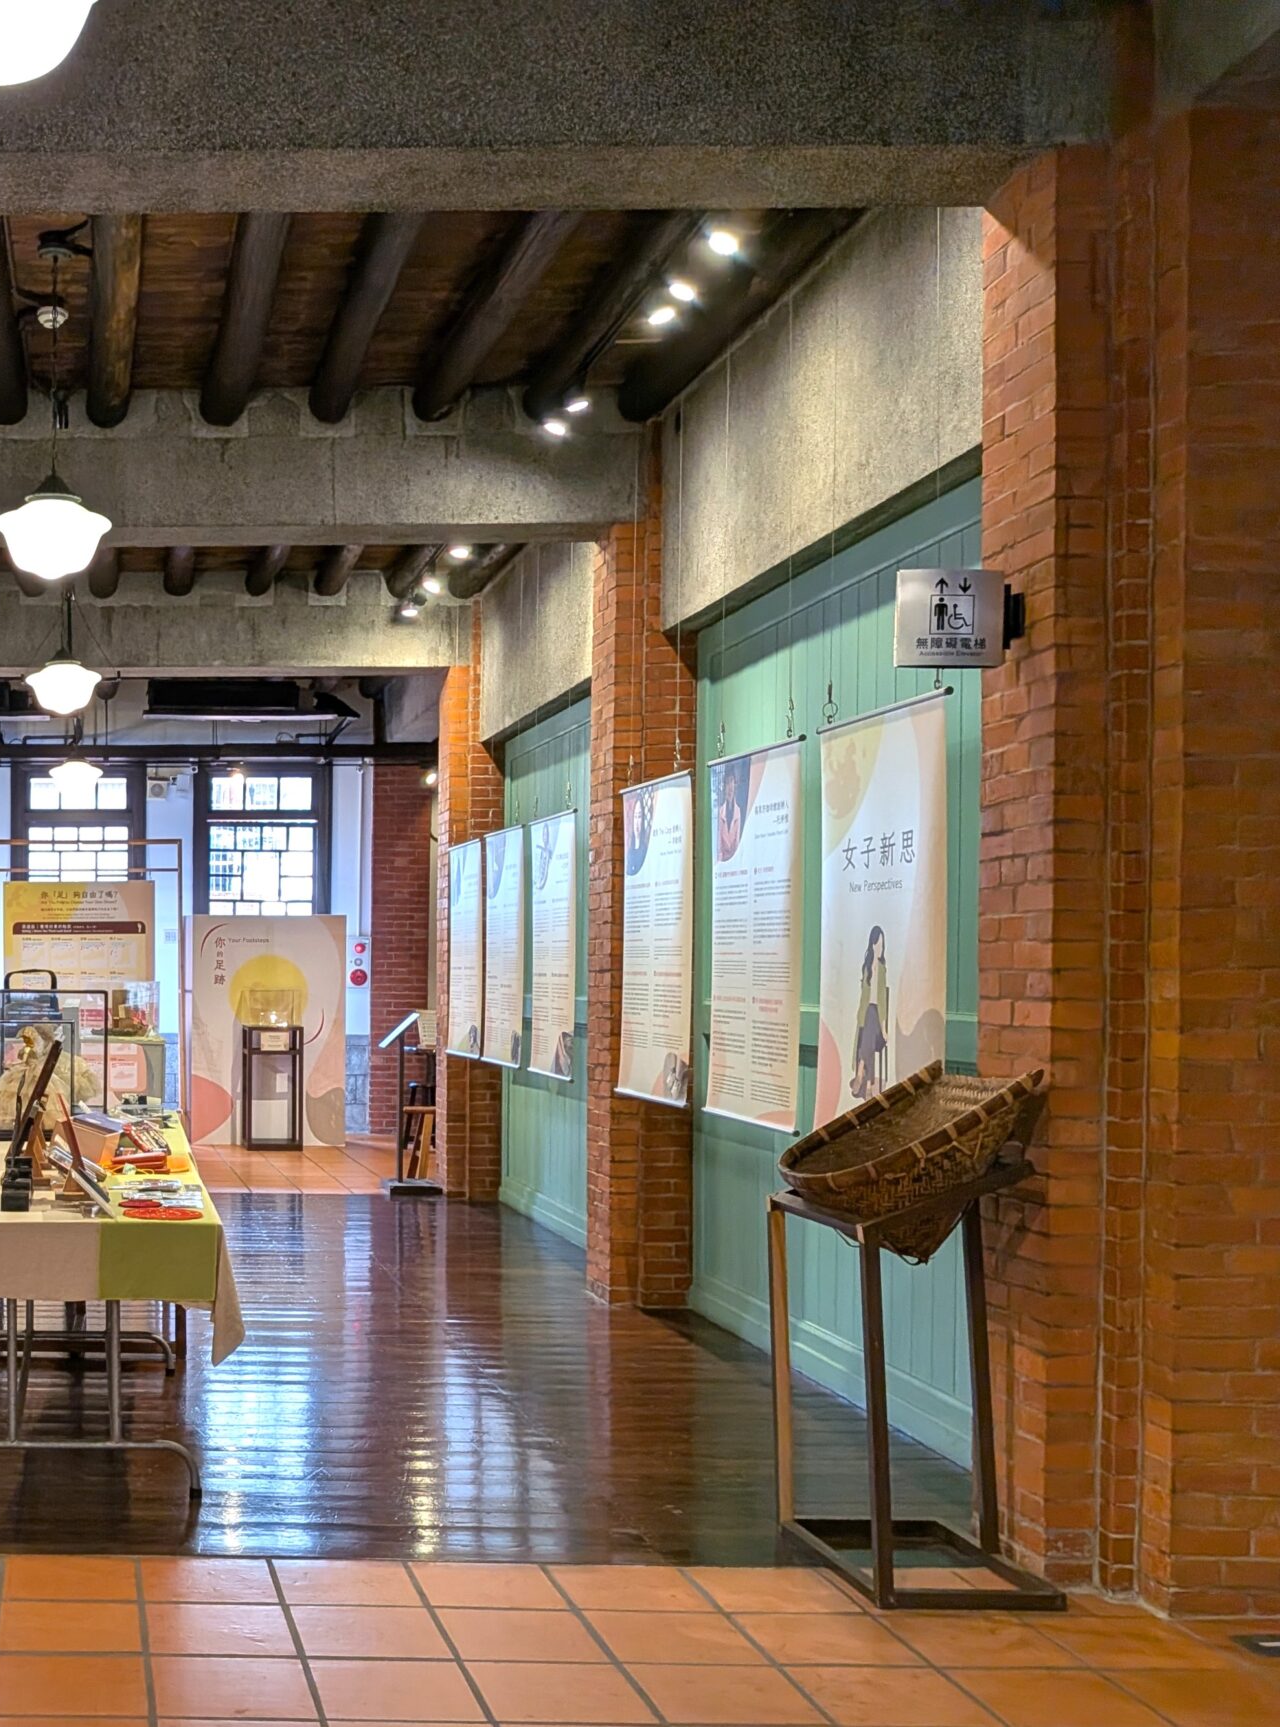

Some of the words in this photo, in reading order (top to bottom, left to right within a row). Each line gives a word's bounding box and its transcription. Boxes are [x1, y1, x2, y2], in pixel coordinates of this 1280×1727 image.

[916, 637, 986, 650] 無障礙電梯
[842, 829, 915, 871] 女子新思
[849, 881, 862, 893] New
[863, 878, 903, 892] Perspectives
[214, 936, 226, 985] 你的足跡
